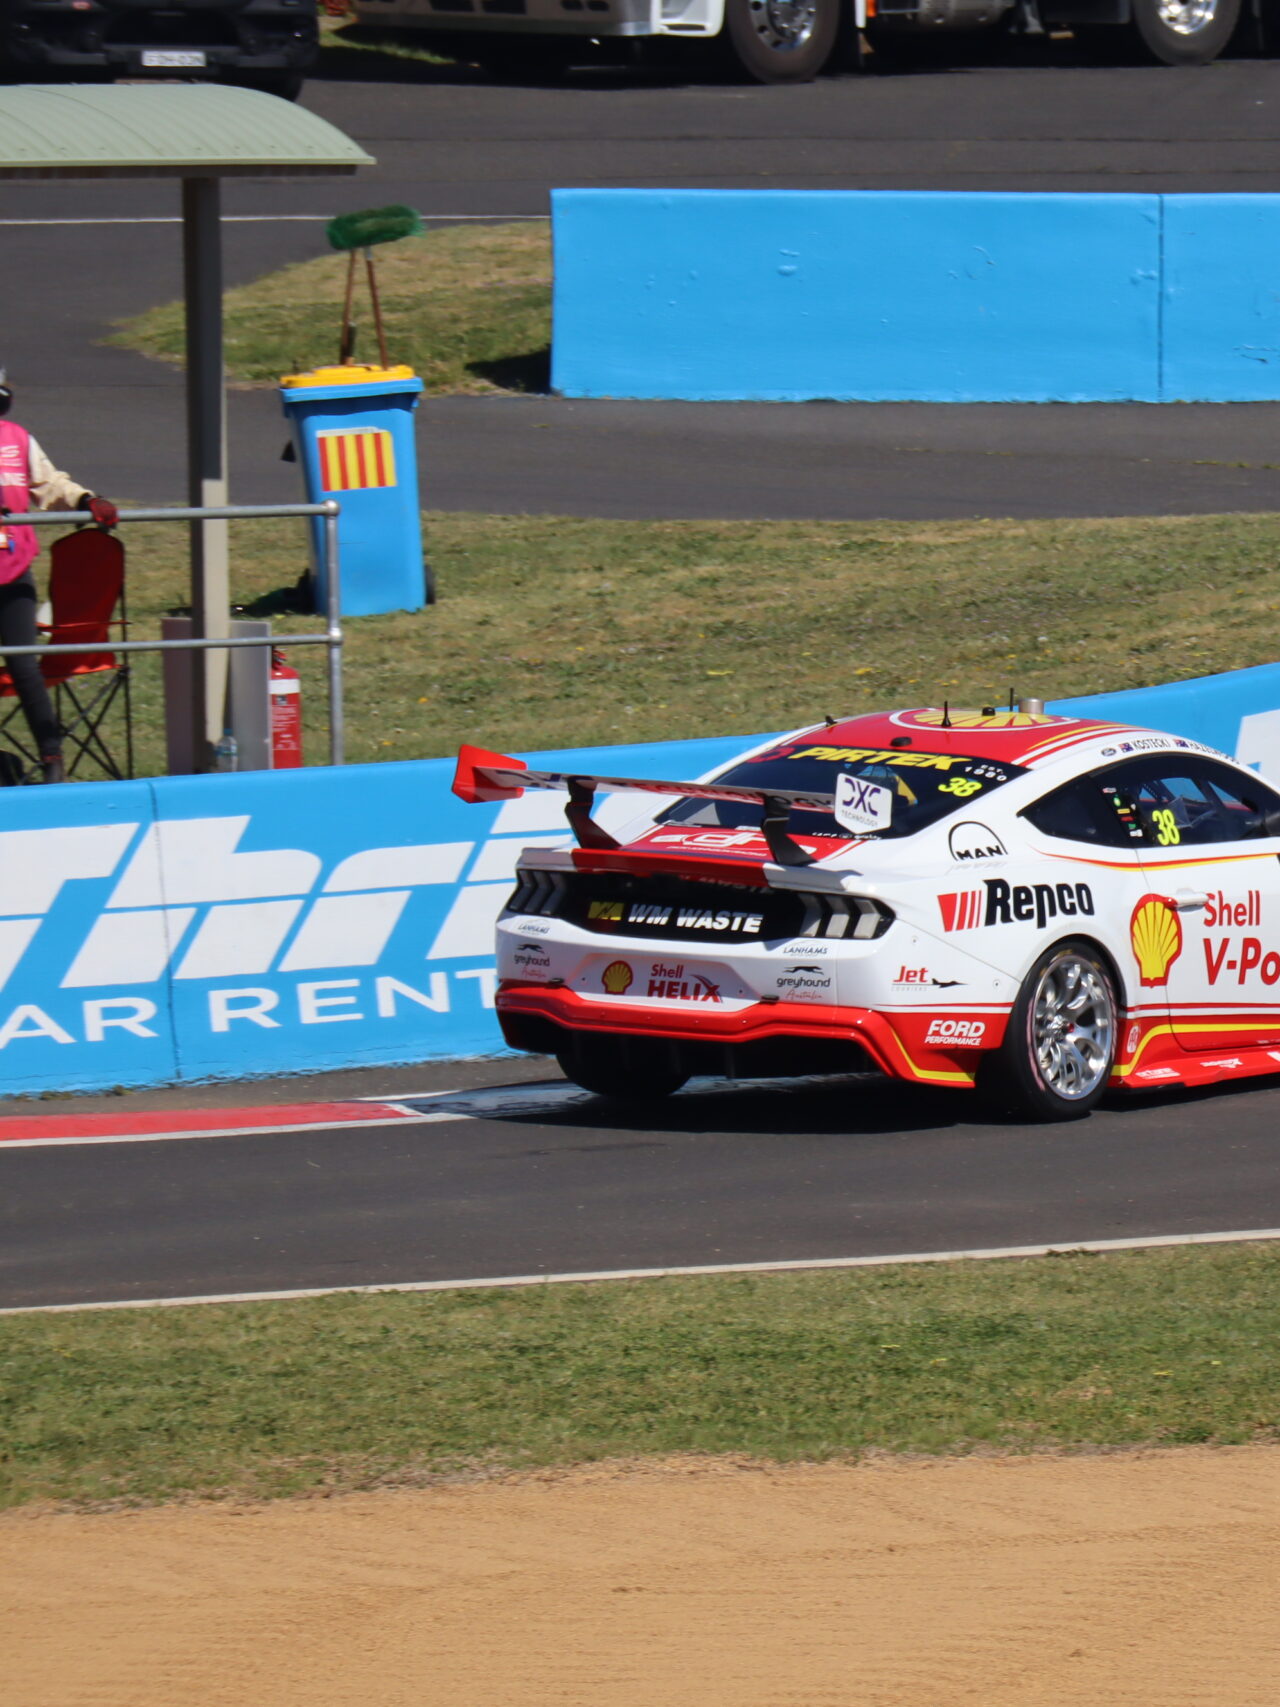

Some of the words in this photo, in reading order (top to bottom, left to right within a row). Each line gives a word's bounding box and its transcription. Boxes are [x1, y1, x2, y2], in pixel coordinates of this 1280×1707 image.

[788, 746, 972, 771] PIRTEK
[965, 766, 1007, 781] 1980
[938, 777, 982, 797] 38
[842, 778, 881, 816] DXC
[841, 809, 878, 828] TECHNOLOGY
[1152, 809, 1180, 846] 38
[956, 845, 1004, 862] MAN
[0, 790, 630, 994] Thri
[982, 878, 1095, 929] Repco
[1203, 890, 1260, 926] Shell
[627, 904, 673, 925] WM
[676, 907, 764, 933] WASTE
[783, 946, 828, 955] LANHAMS
[514, 955, 550, 967] greyhound
[651, 964, 684, 979] Shell
[893, 965, 928, 983] Jet
[647, 977, 723, 1003] HELIX
[776, 977, 831, 989] greyhound
[0, 996, 158, 1050] AR
[208, 968, 497, 1034] RENT
[927, 1020, 985, 1037] FORD
[924, 1035, 982, 1046] PERFORMANCE
